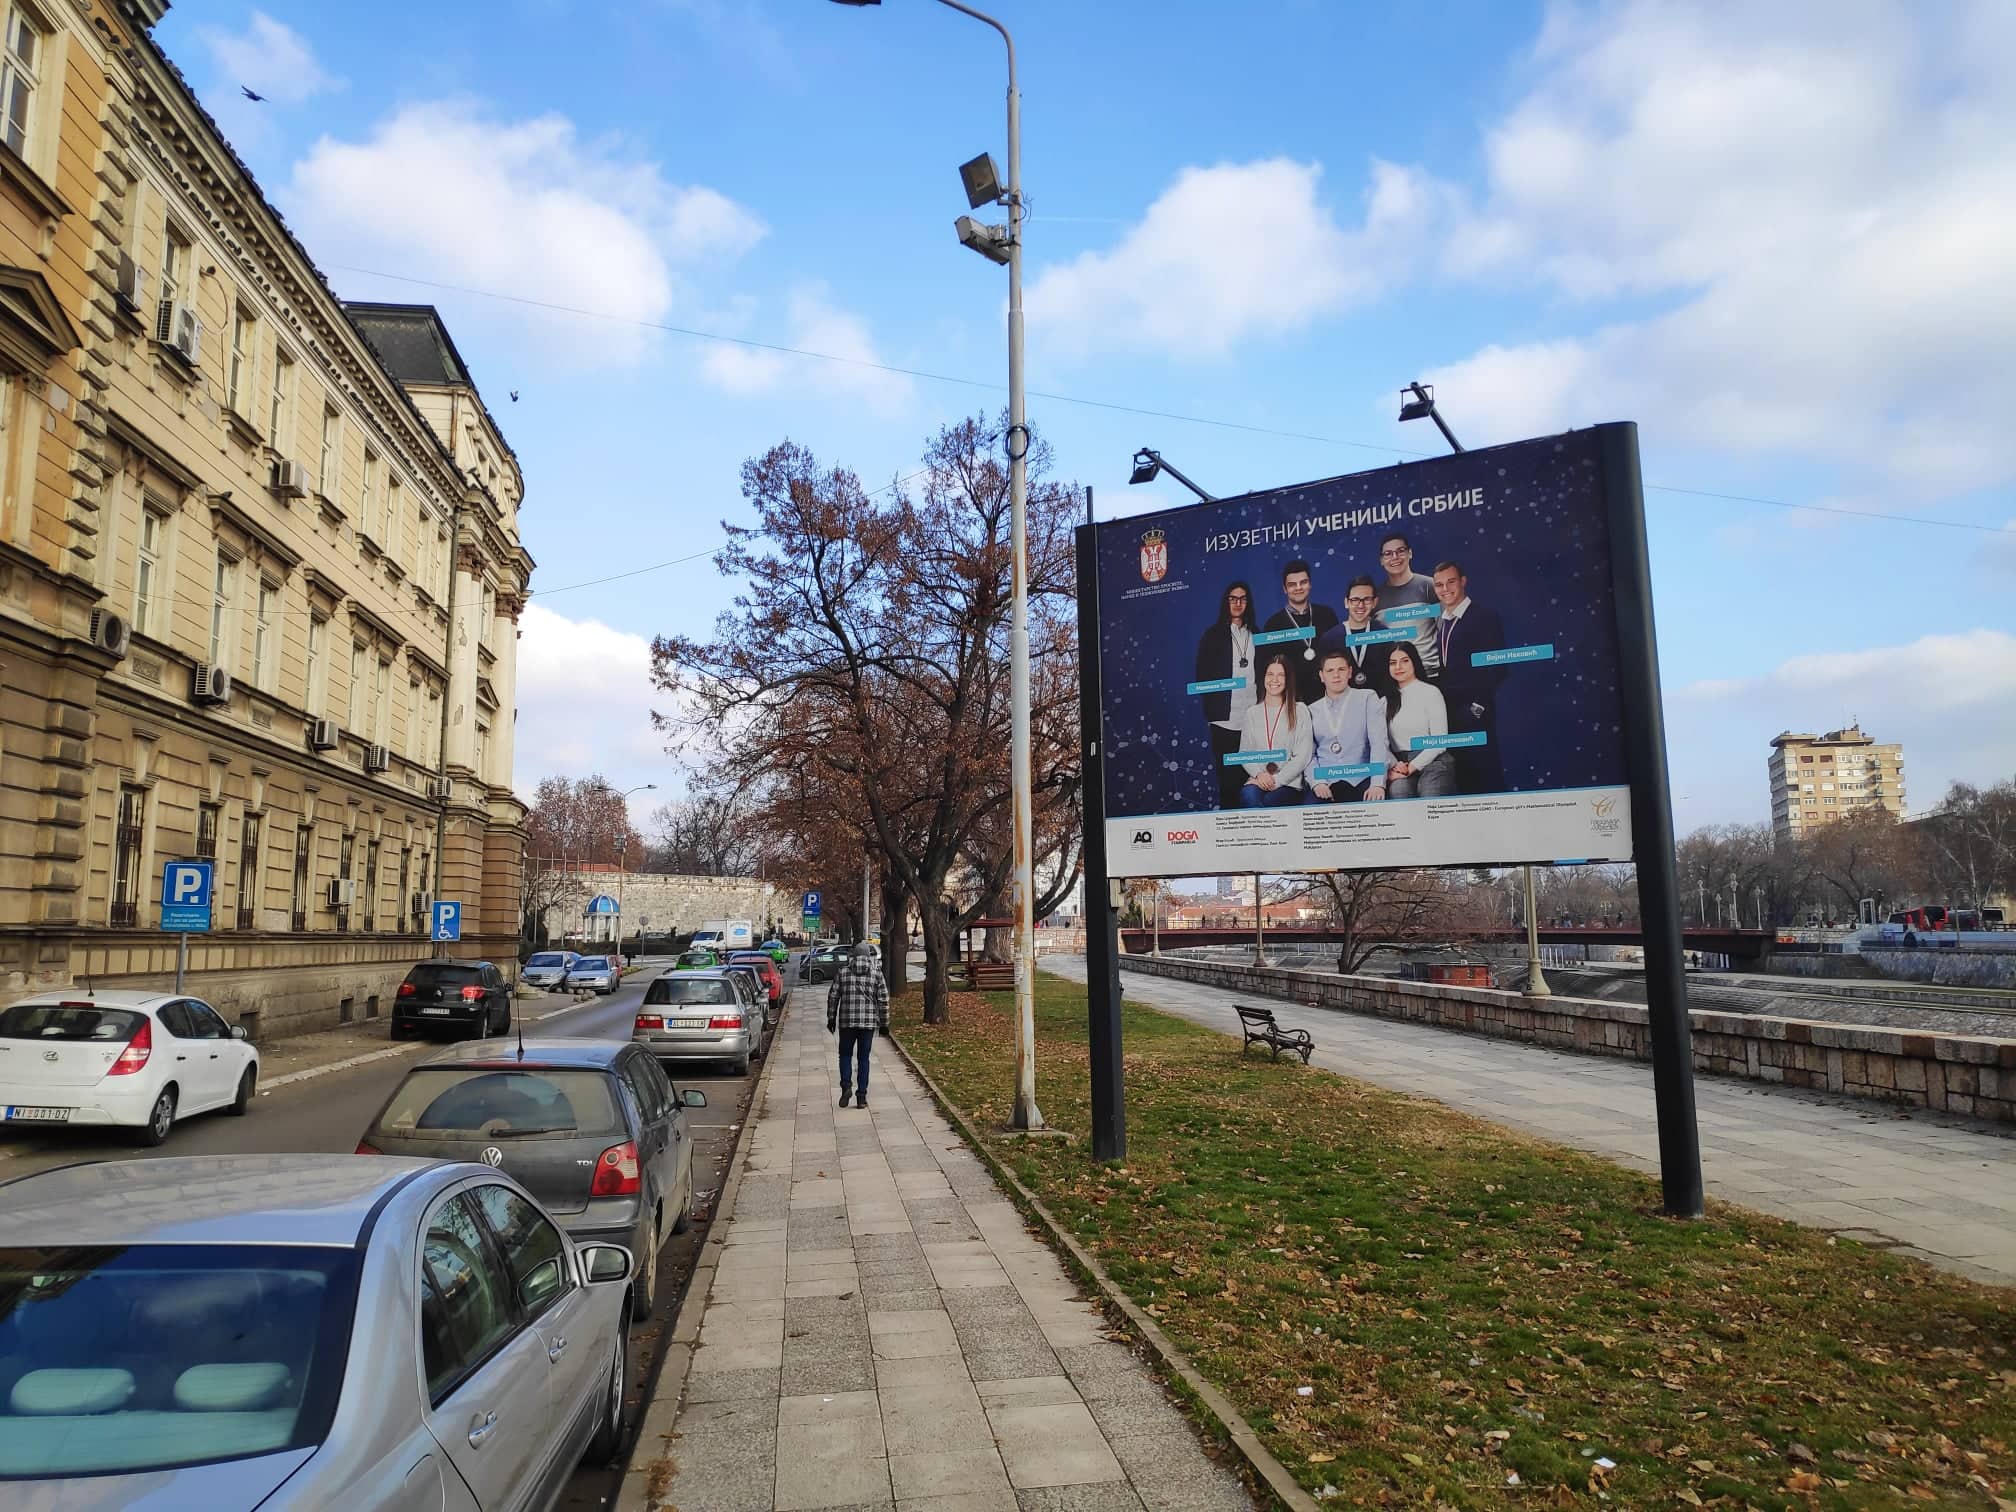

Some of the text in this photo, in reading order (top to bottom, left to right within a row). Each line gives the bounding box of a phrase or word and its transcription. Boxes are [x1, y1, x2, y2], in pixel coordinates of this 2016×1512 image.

[1205, 488, 1484, 553] ИЗУЗЕТНИ УЧЕНИЦИ СРБИЈЕ
[1133, 831, 1153, 844] AQ
[1167, 830, 1199, 842] DOGA
[807, 894, 817, 907] P
[440, 904, 455, 924] P
